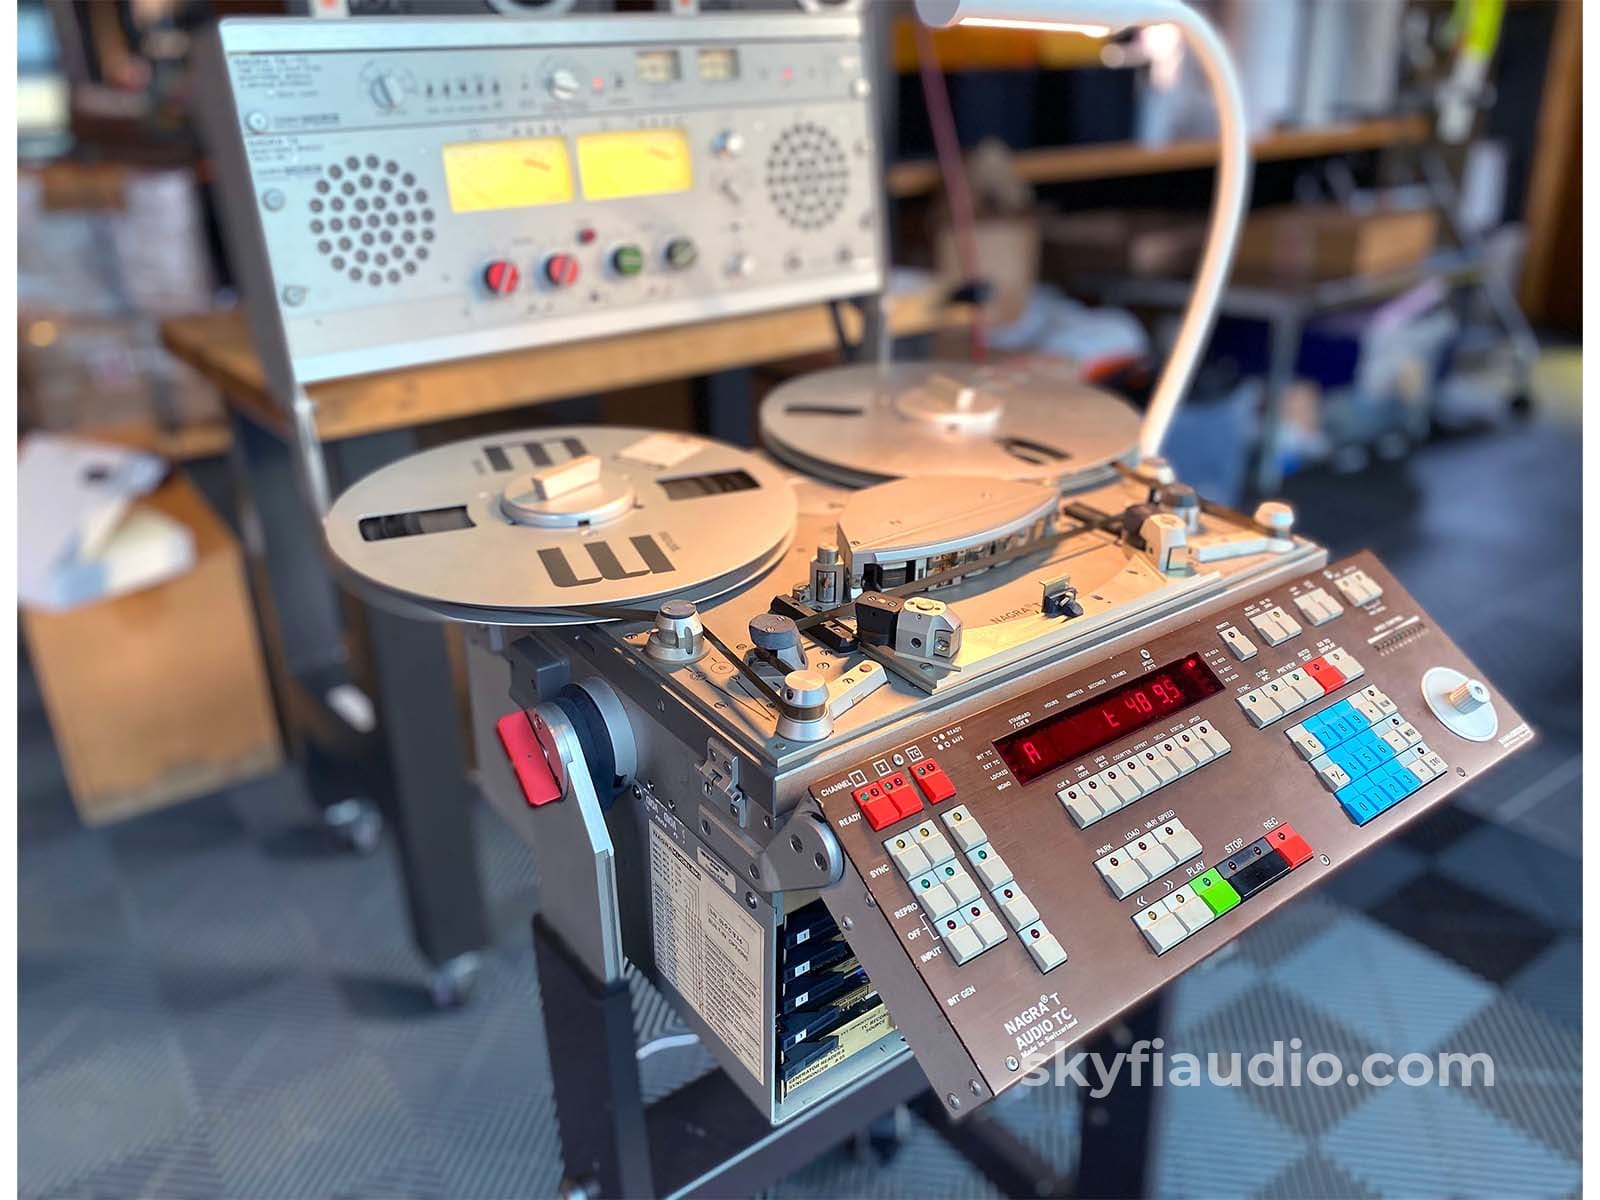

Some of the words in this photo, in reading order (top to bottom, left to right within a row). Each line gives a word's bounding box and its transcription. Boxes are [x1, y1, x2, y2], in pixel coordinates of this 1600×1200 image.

[908, 749, 921, 759] TC
[820, 780, 852, 797] CHANNEL
[838, 812, 862, 828] READY
[1157, 809, 1175, 823] SPEED
[1263, 816, 1279, 830] REC
[1124, 828, 1141, 841] LOAD
[1095, 842, 1114, 857] PARK
[1224, 837, 1245, 854] STOP
[869, 864, 890, 879] SYNC
[1186, 860, 1206, 877] PLAY
[894, 902, 919, 920] REPRO
[907, 927, 921, 941] OFF
[920, 946, 942, 963] INPUT
[947, 993, 961, 1007] INT
[961, 985, 977, 1000] GEN
[1049, 992, 1061, 1005] T
[1015, 1019, 1054, 1051] AUDIO
[1051, 1007, 1073, 1025] TC
[1020, 1045, 1038, 1058] Made
[1044, 1018, 1078, 1043] Switzerland
